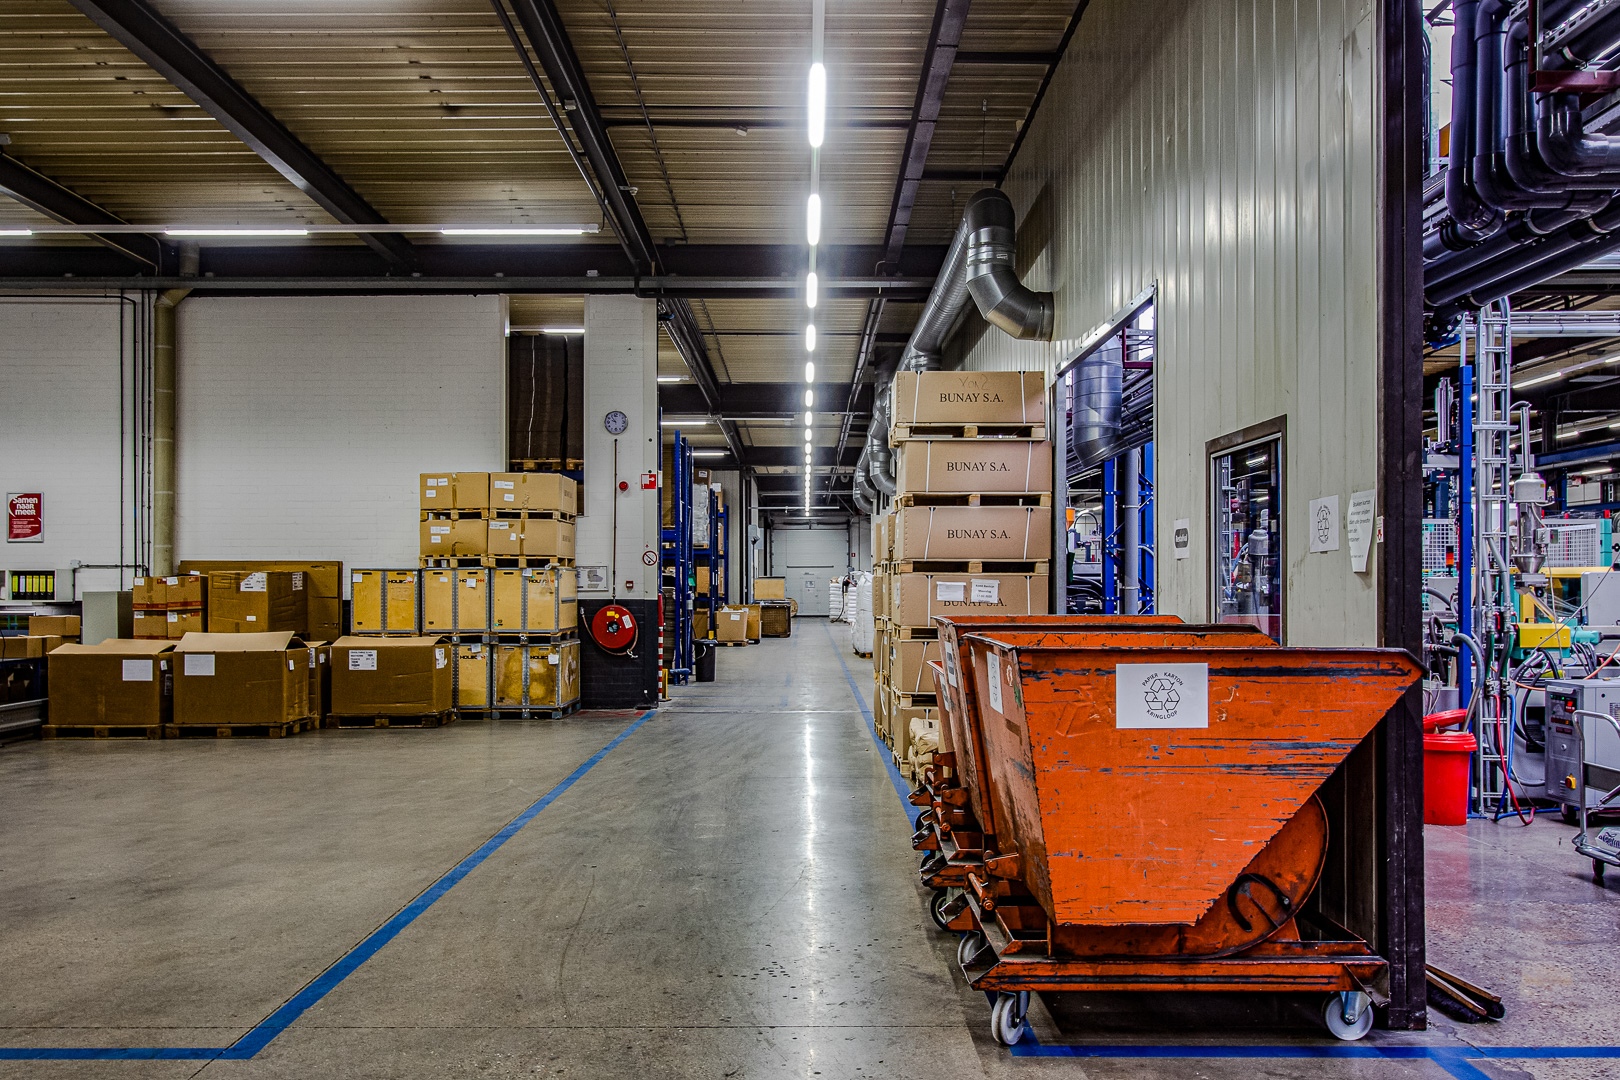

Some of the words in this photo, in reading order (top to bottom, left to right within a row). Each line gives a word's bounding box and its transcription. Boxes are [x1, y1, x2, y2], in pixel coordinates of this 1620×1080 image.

[940, 393, 980, 402] BUNAY
[983, 392, 1004, 402] S.A.
[946, 462, 987, 471] BUNAY
[989, 462, 1011, 471] S.A.
[947, 530, 988, 539] BUNAY
[990, 530, 1011, 539] S.A.
[1142, 673, 1158, 686] PAPIER
[1164, 672, 1183, 685] KARTON
[1146, 709, 1178, 720] KRINGLOOP
